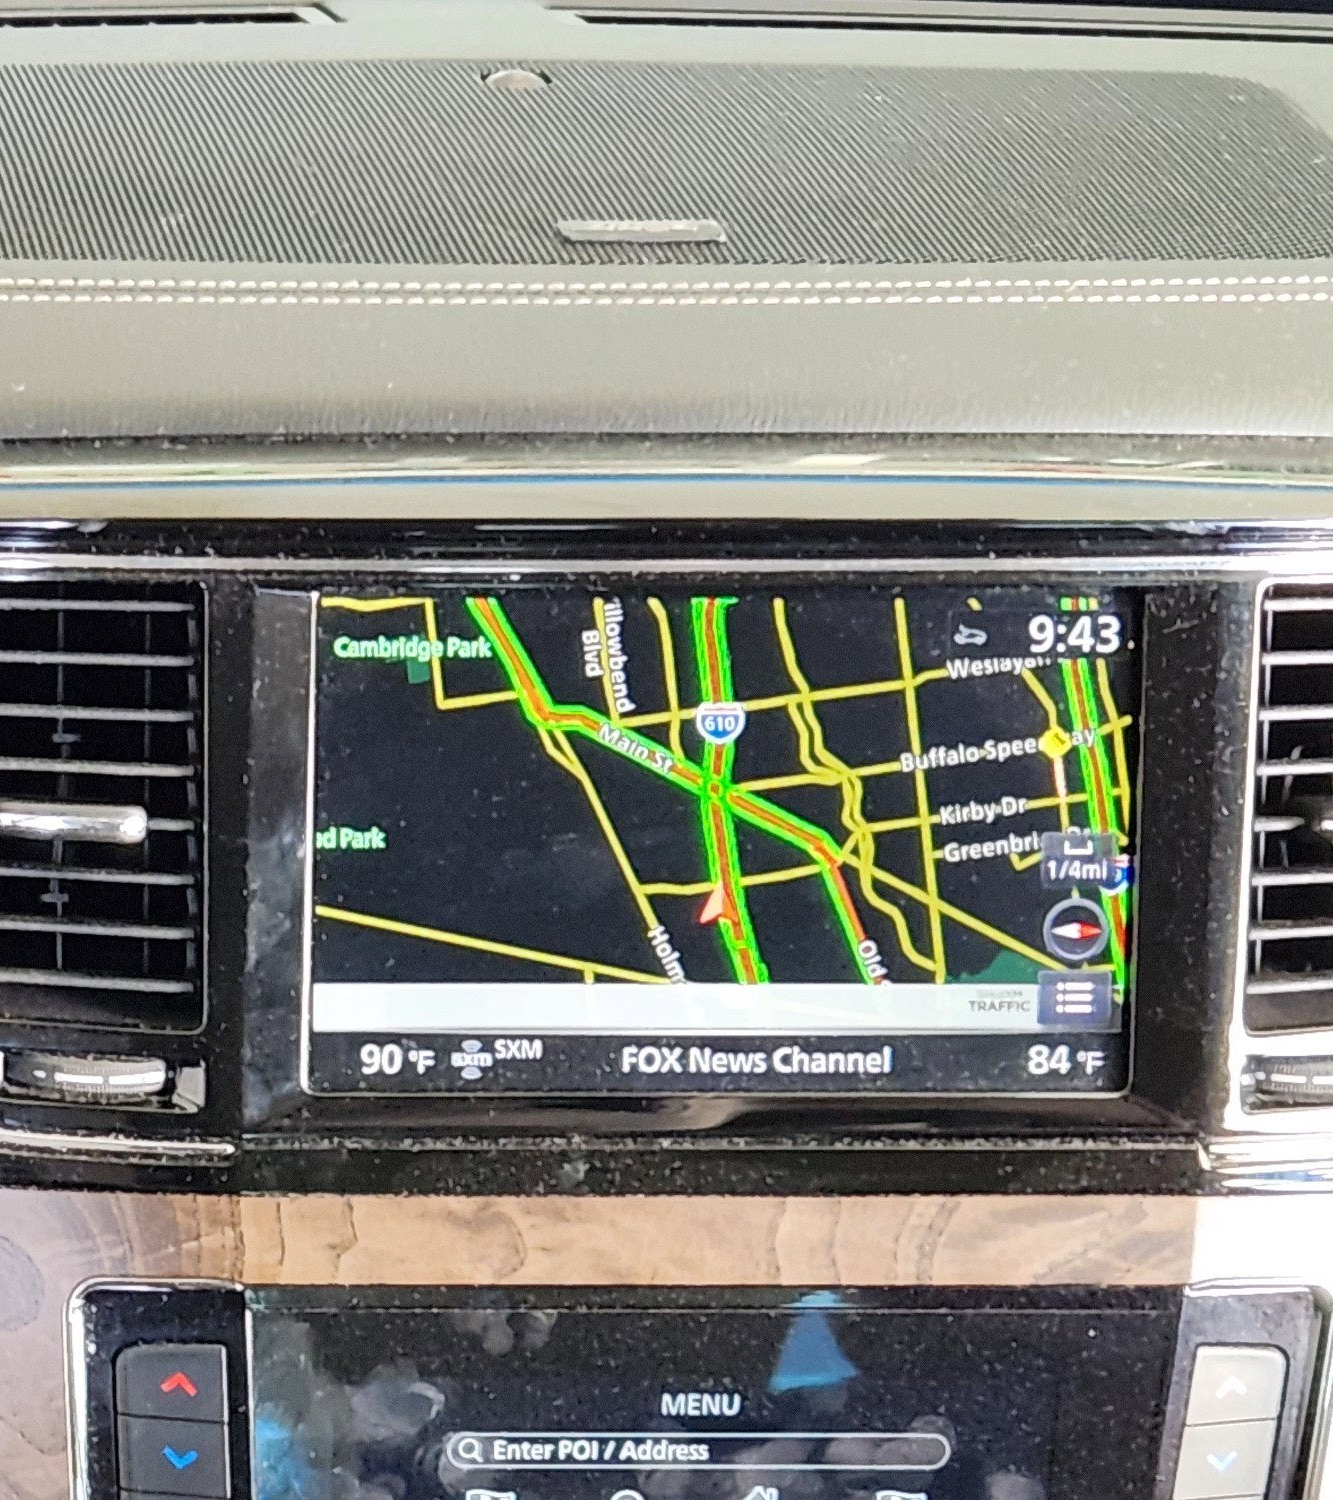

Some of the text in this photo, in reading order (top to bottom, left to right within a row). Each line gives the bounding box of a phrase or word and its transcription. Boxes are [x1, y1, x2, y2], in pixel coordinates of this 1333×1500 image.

[333, 635, 493, 660] Cambridge Park
[1028, 614, 1121, 654] 9:43
[582, 629, 605, 678] Blvd
[604, 596, 637, 713] illowbend
[704, 716, 735, 733] 610
[598, 721, 674, 775] Main St
[900, 744, 980, 772] Buffalo
[939, 796, 1028, 827] Kirby Dr
[339, 826, 387, 849] Park
[858, 939, 889, 979] Old
[968, 999, 1032, 1013] TRAFFIC
[360, 1044, 403, 1075] 90
[494, 1038, 544, 1060] SXM
[621, 1048, 683, 1074] FOX
[689, 1048, 767, 1074] News
[772, 1047, 893, 1075] Channel
[1027, 1046, 1071, 1075] 84
[661, 1393, 741, 1417] MENU
[492, 1438, 710, 1463] Enter POI / Address
